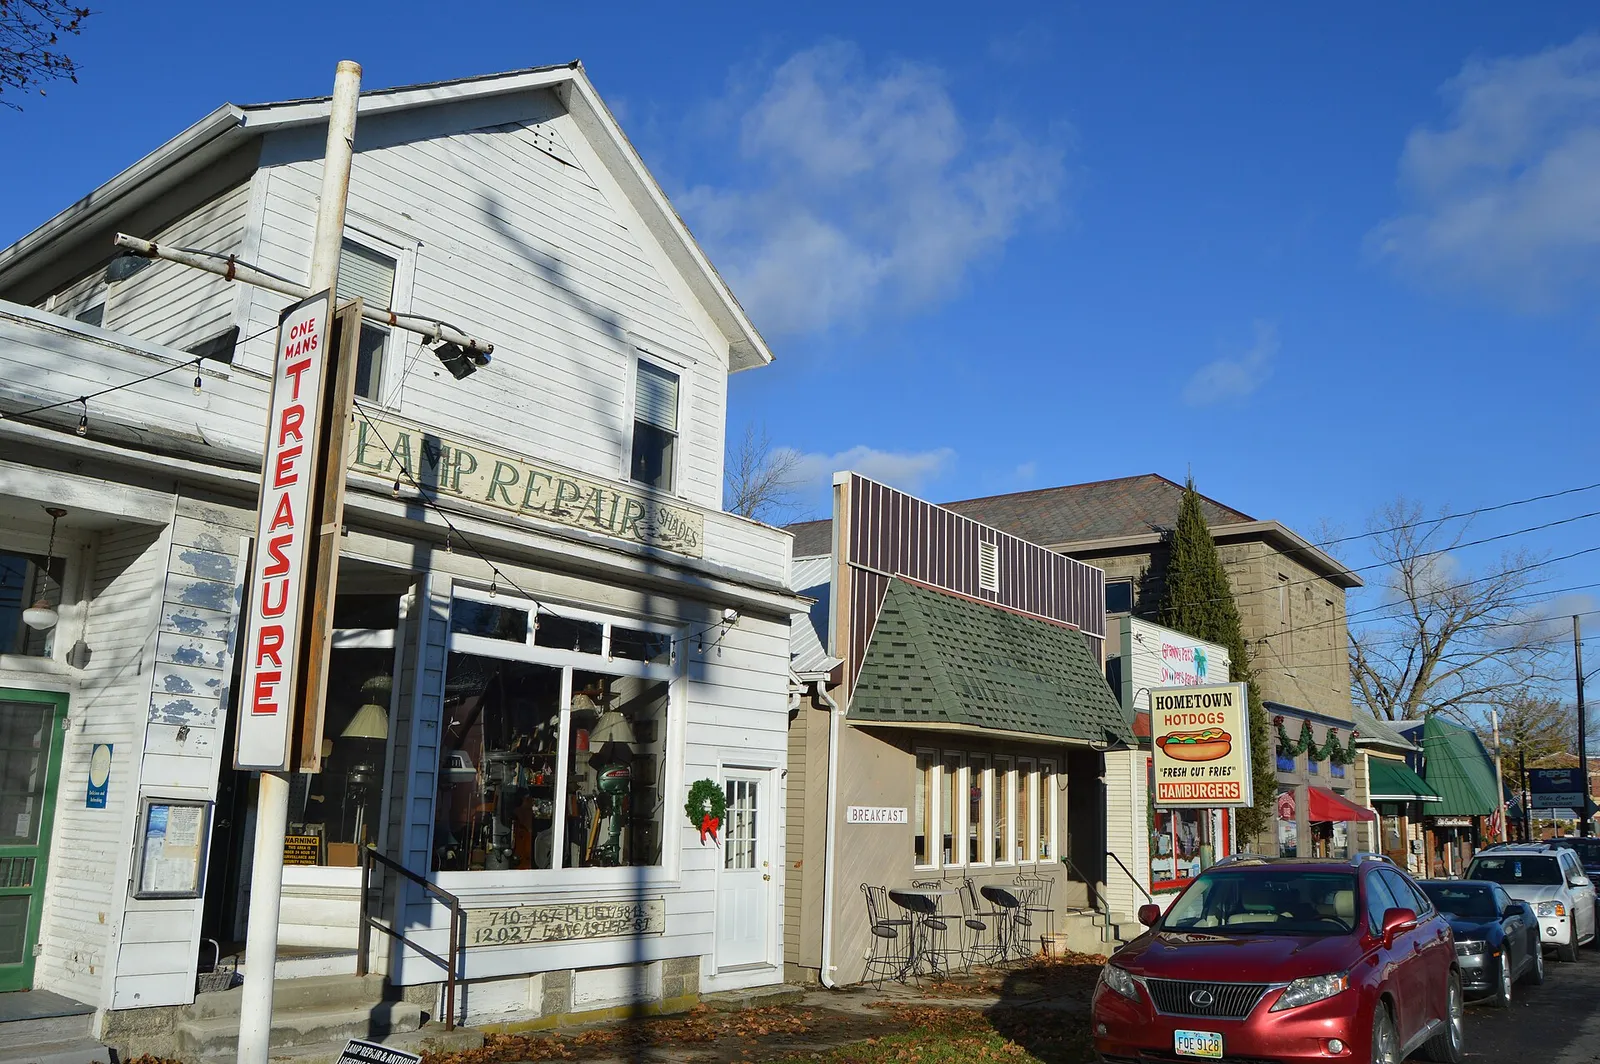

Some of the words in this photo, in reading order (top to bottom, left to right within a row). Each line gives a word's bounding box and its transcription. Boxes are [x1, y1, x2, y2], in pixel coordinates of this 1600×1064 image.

[290, 317, 316, 340] ONE
[284, 334, 318, 361] MANS
[354, 419, 478, 495] LAMP
[485, 459, 646, 541] REPAIR
[657, 506, 700, 548] SHADES
[251, 358, 312, 716] TREASURE
[1155, 692, 1233, 710] HOMETOWN
[1164, 712, 1225, 726] HOTDOGS
[1190, 767, 1205, 777] CUT
[1538, 769, 1571, 778] PEPSI
[1160, 783, 1239, 798] HAMBURGERS
[852, 809, 904, 822] BREAKFAST
[474, 926, 537, 943] 12027
[345, 1042, 362, 1055] LAMP
[360, 1045, 383, 1060] REPAIR
[380, 1051, 388, 1063] &
[1197, 1038, 1219, 1051] 9128
